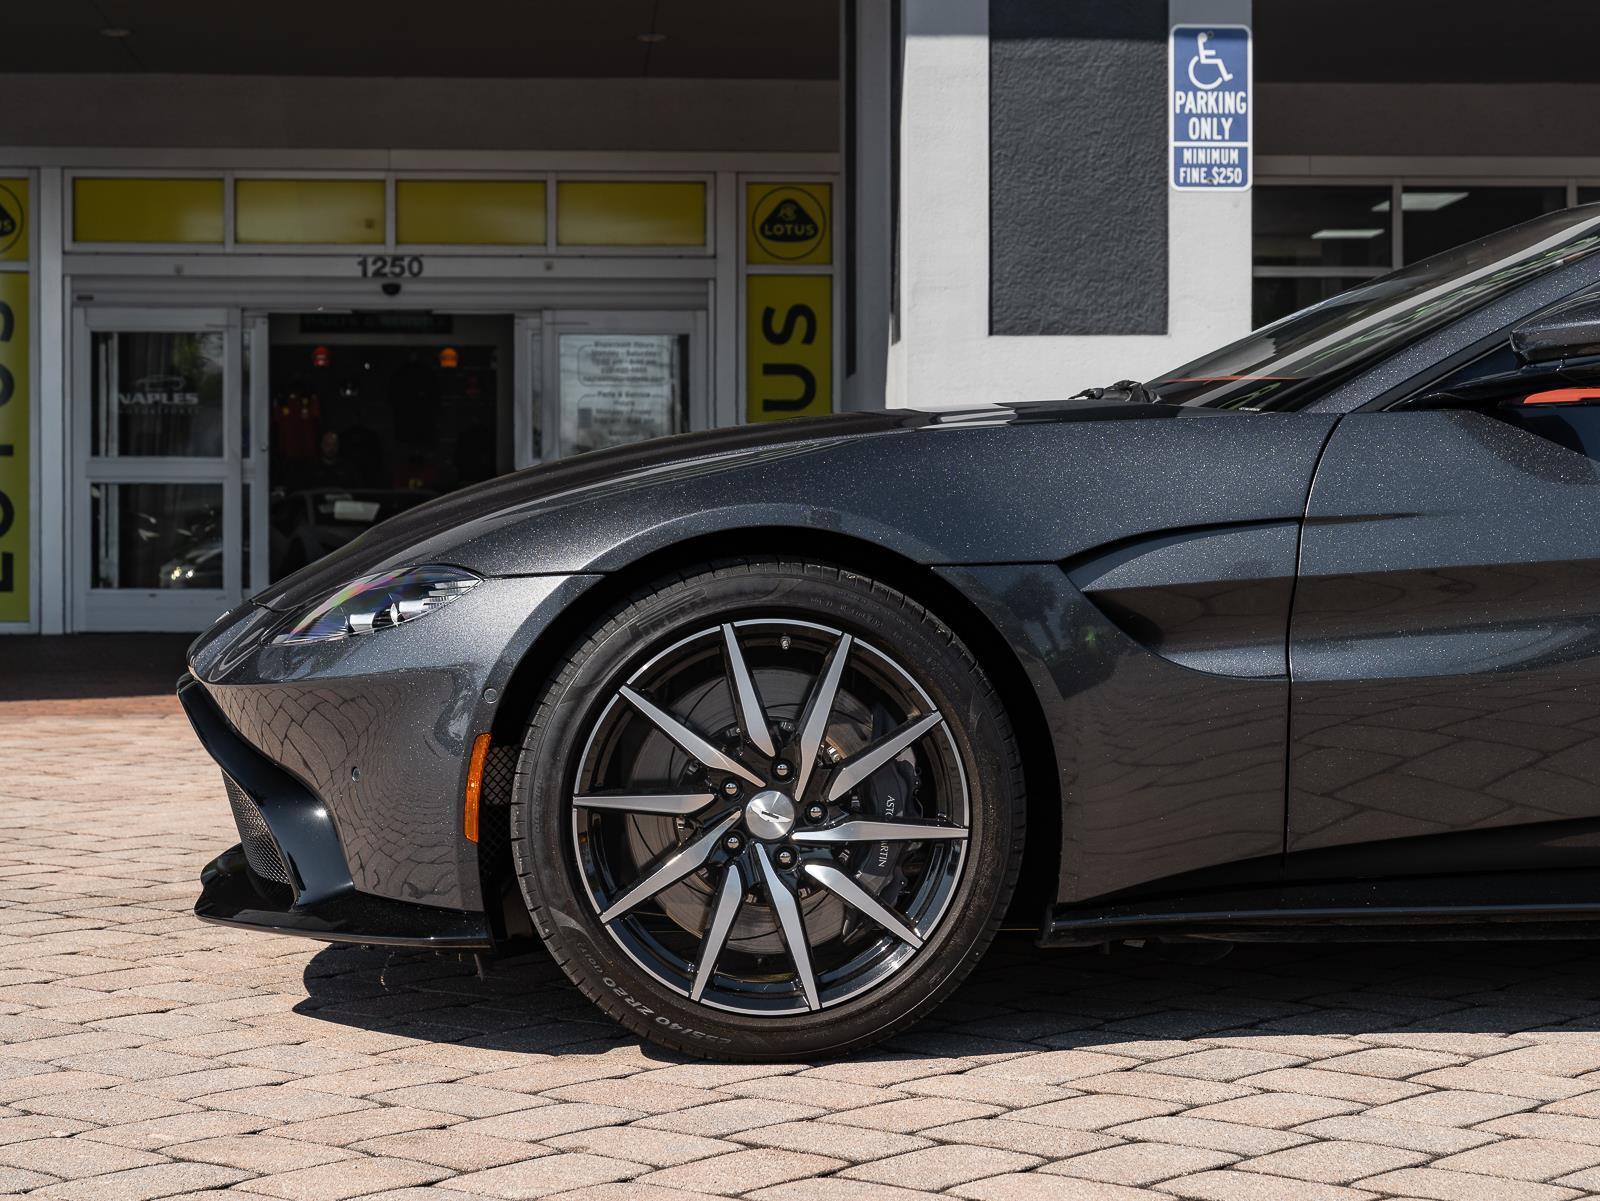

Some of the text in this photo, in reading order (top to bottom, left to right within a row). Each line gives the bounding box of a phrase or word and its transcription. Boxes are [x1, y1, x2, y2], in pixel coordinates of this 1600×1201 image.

[1175, 90, 1247, 115] PARKING
[1188, 117, 1233, 141] ONLY
[1183, 148, 1239, 165] MINIMUM
[1179, 166, 1243, 186] FINE $250
[763, 222, 816, 236] LOTUS
[357, 255, 424, 278] 1250
[602, 976, 655, 1017] ZR20
